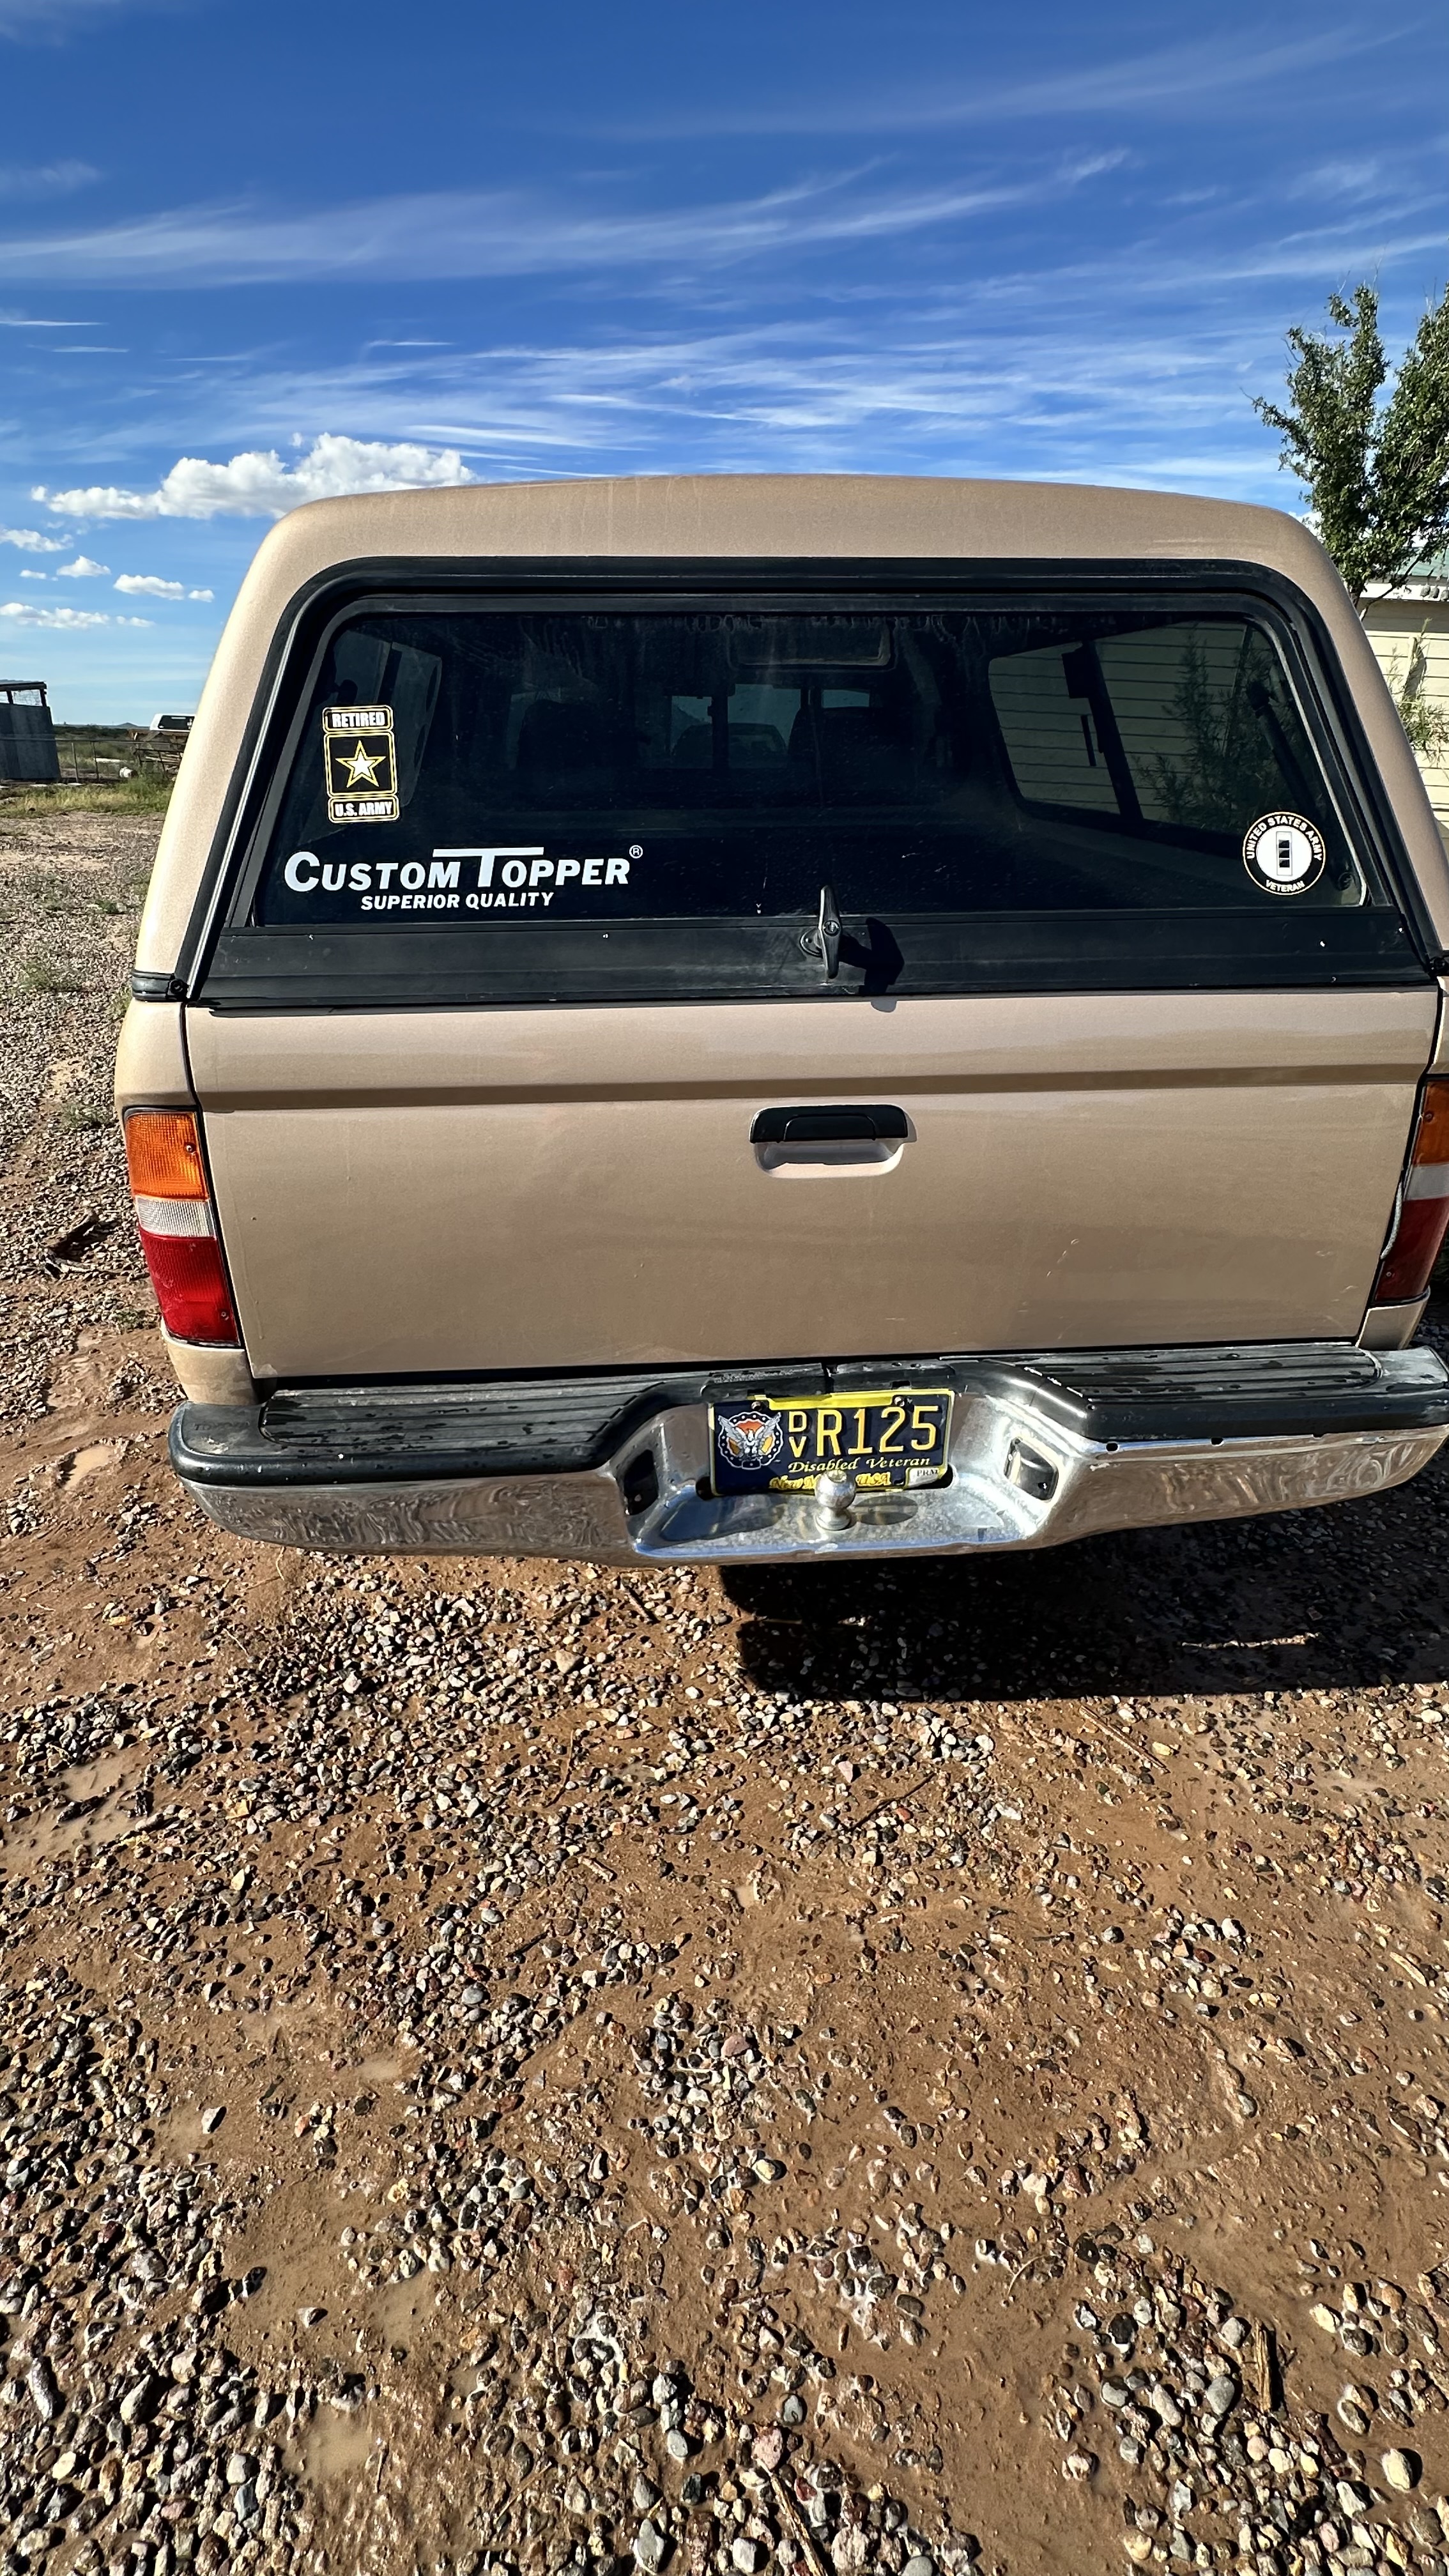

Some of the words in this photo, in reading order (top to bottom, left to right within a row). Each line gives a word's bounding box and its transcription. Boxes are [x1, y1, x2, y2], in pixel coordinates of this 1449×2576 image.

[332, 712, 385, 728] RETIRED
[335, 803, 357, 817] U.S.
[358, 801, 393, 816] ARMY
[1246, 822, 1267, 859] UNITED
[1267, 815, 1308, 831] STATES
[1305, 831, 1322, 861] ARMY
[284, 851, 461, 893] CUSTOM
[1266, 879, 1305, 893] VETERAN
[361, 894, 459, 910] SUPERIOR
[465, 892, 554, 910] QUALITY
[816, 1405, 939, 1457] R125
[788, 1457, 861, 1473] Disabled
[865, 1457, 930, 1469] Veteran
[855, 1471, 892, 1486] USA
